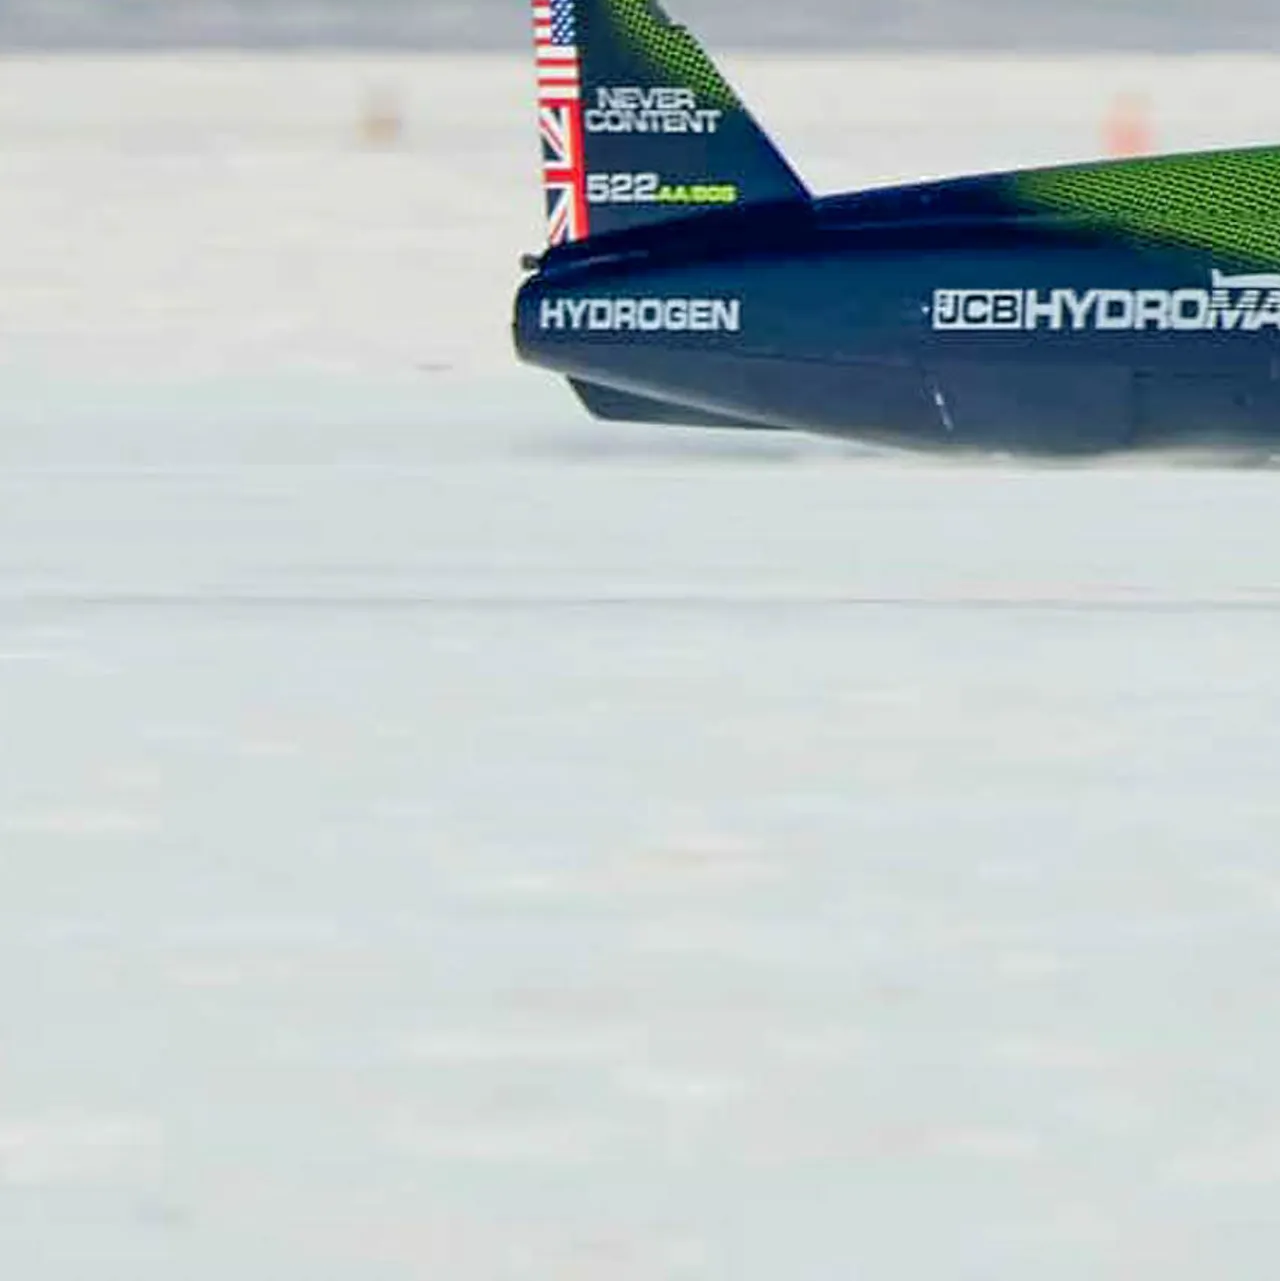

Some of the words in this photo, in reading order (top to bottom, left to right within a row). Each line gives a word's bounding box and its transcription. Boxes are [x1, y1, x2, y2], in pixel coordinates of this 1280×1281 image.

[597, 86, 696, 109] NEVER
[584, 109, 722, 133] CONTENT
[586, 172, 660, 203] 522
[539, 297, 741, 331] HYDROGEN
[936, 291, 1020, 326] JCB
